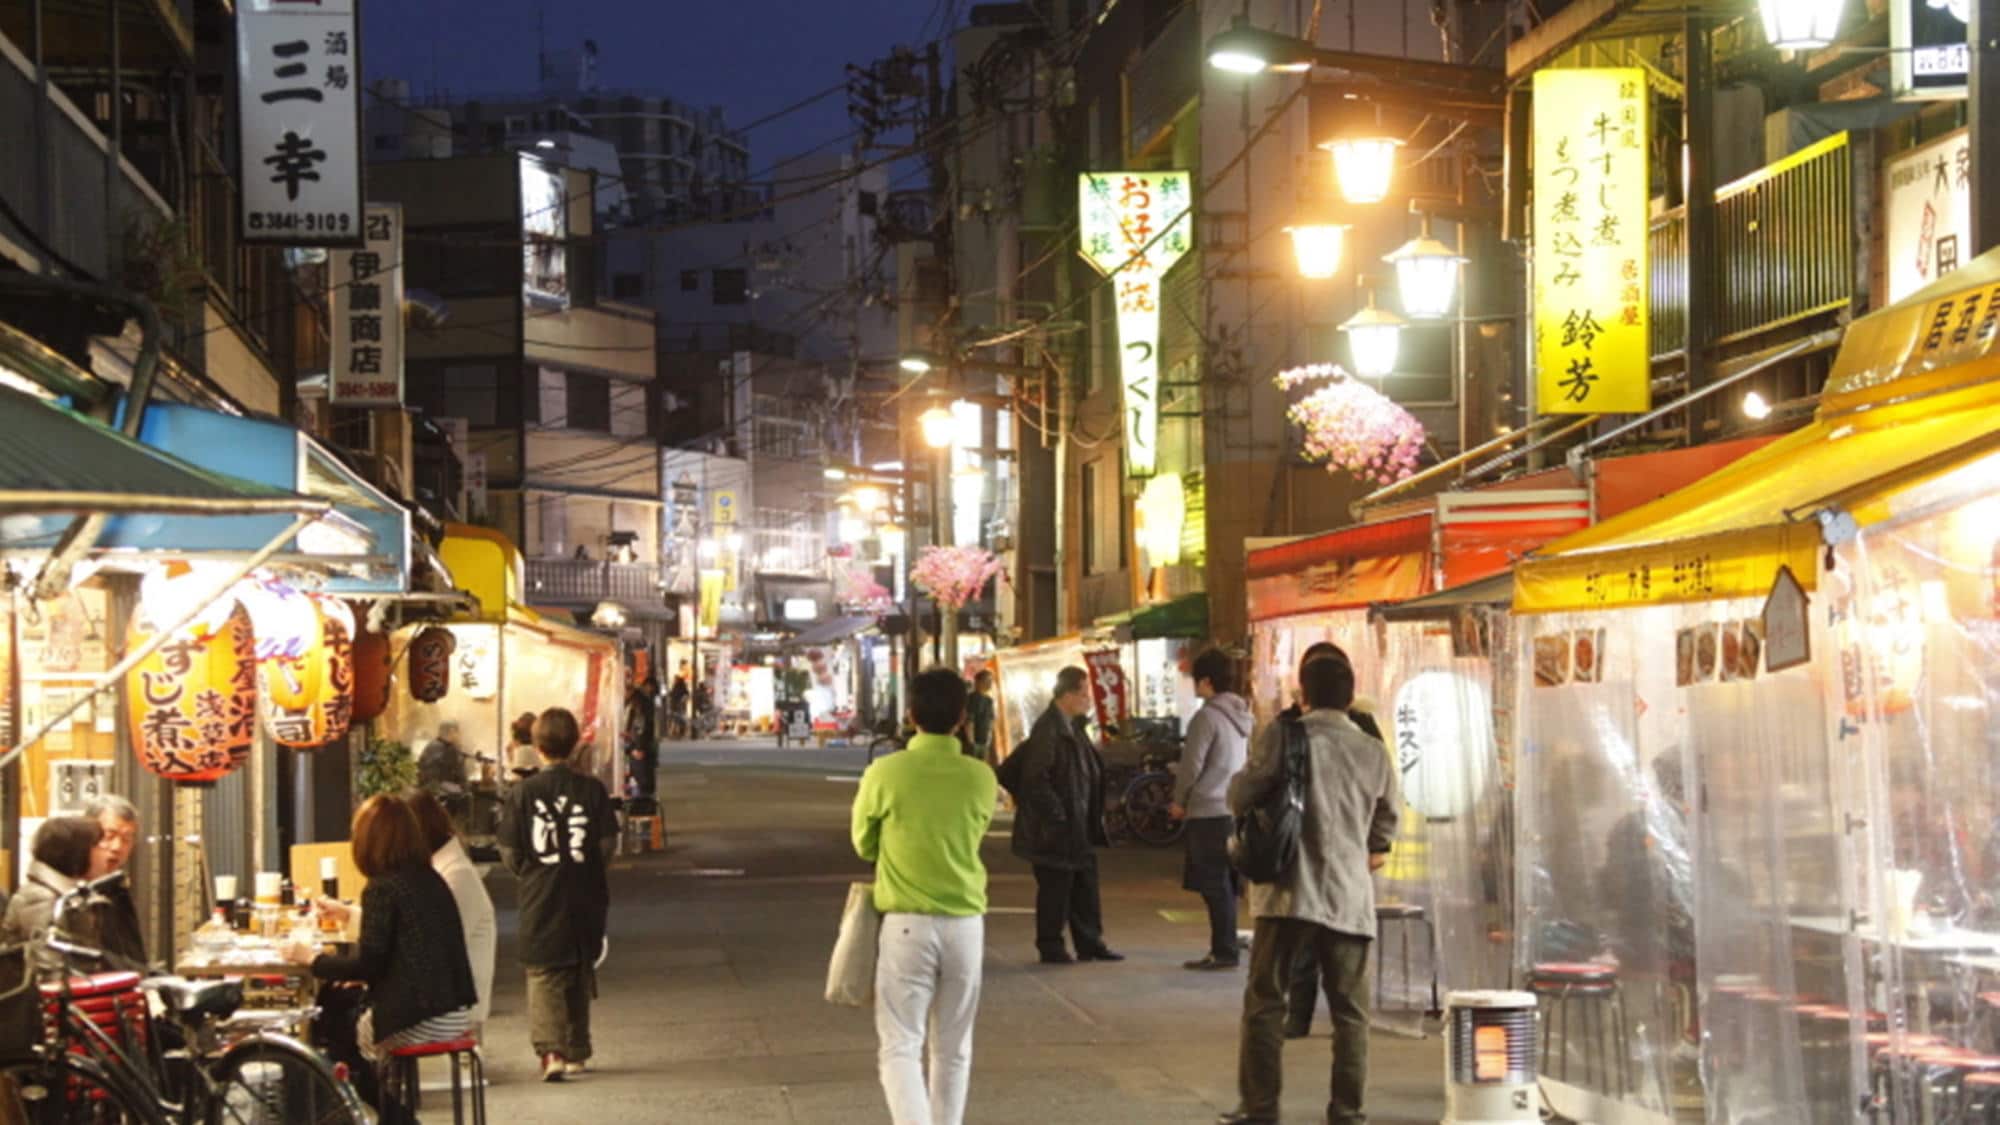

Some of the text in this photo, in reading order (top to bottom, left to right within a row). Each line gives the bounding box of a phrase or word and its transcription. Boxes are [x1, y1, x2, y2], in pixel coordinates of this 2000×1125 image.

[323, 31, 349, 90] 酒場
[260, 40, 327, 201] 三幸
[266, 211, 350, 232] 3841-9109
[1125, 340, 1153, 448] つくし
[1557, 308, 1605, 404] 鈴芳
